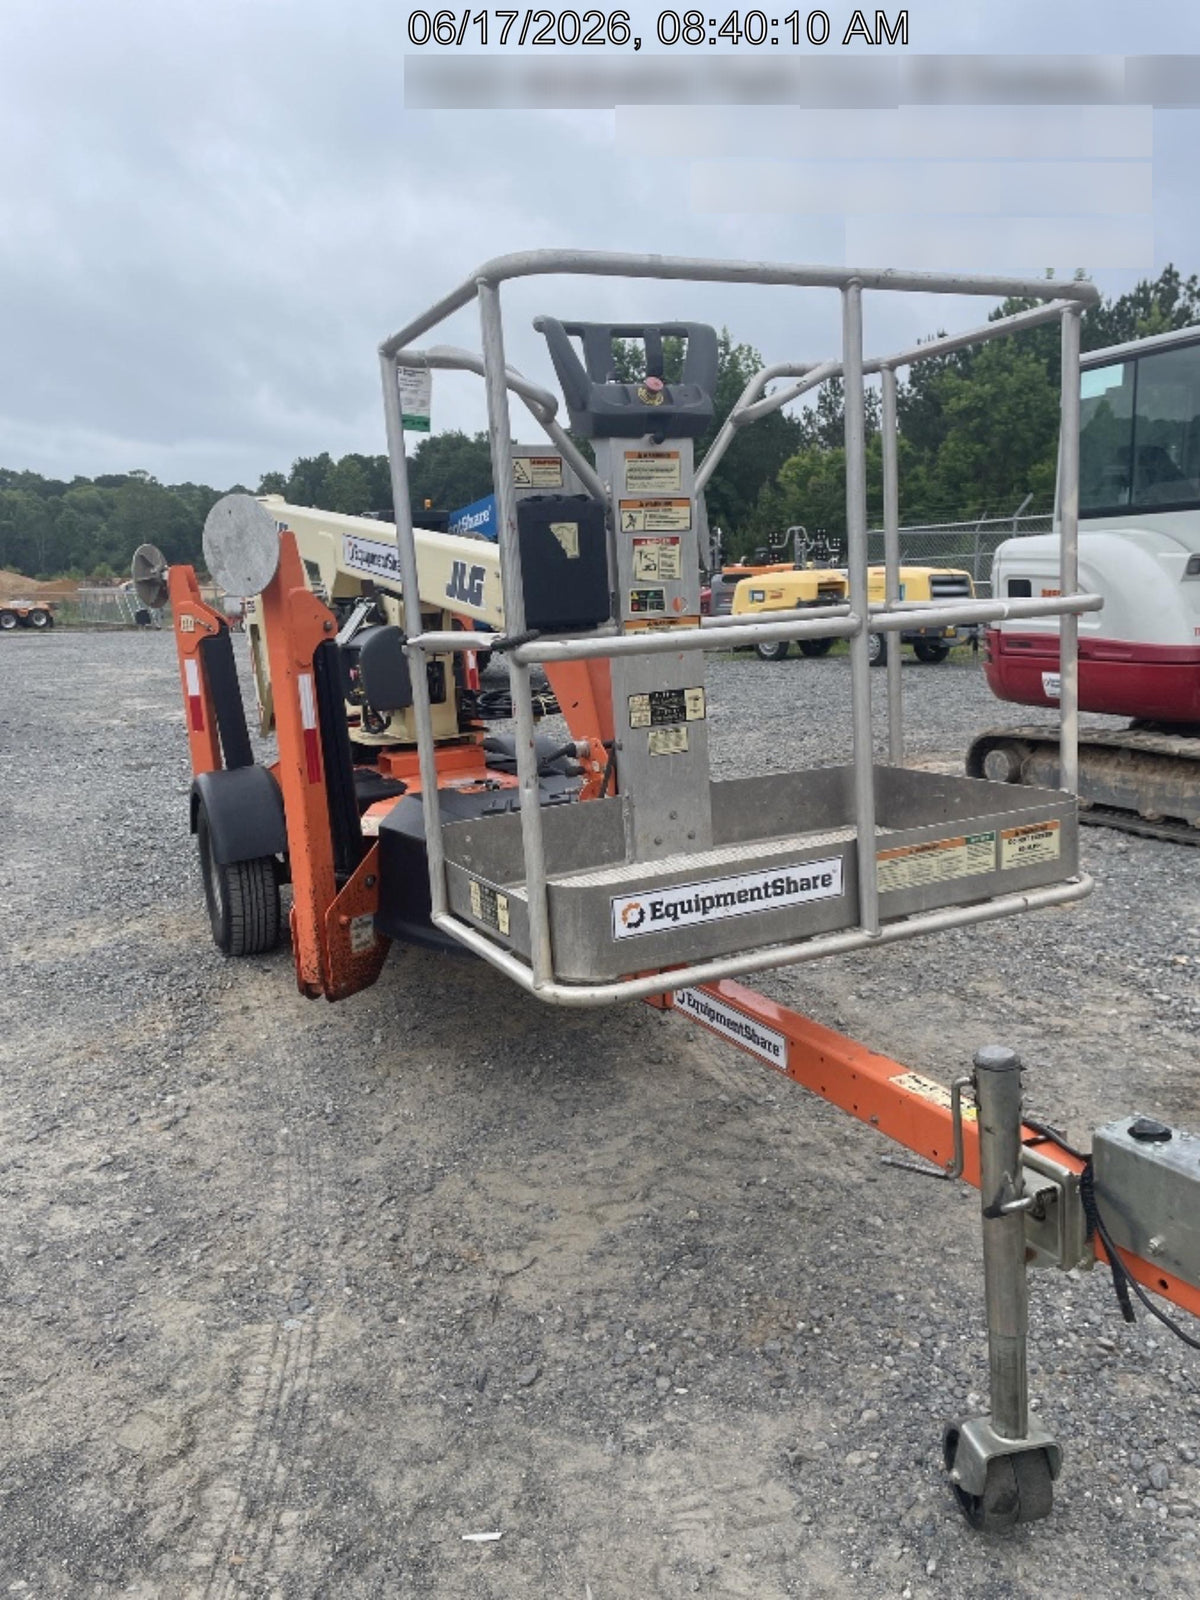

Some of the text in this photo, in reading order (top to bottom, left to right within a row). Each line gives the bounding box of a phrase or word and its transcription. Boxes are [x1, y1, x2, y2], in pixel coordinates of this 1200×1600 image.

[445, 560, 486, 607] JLG
[649, 872, 833, 922] EquipmentShare
[686, 991, 781, 1057] EquipmentShare
